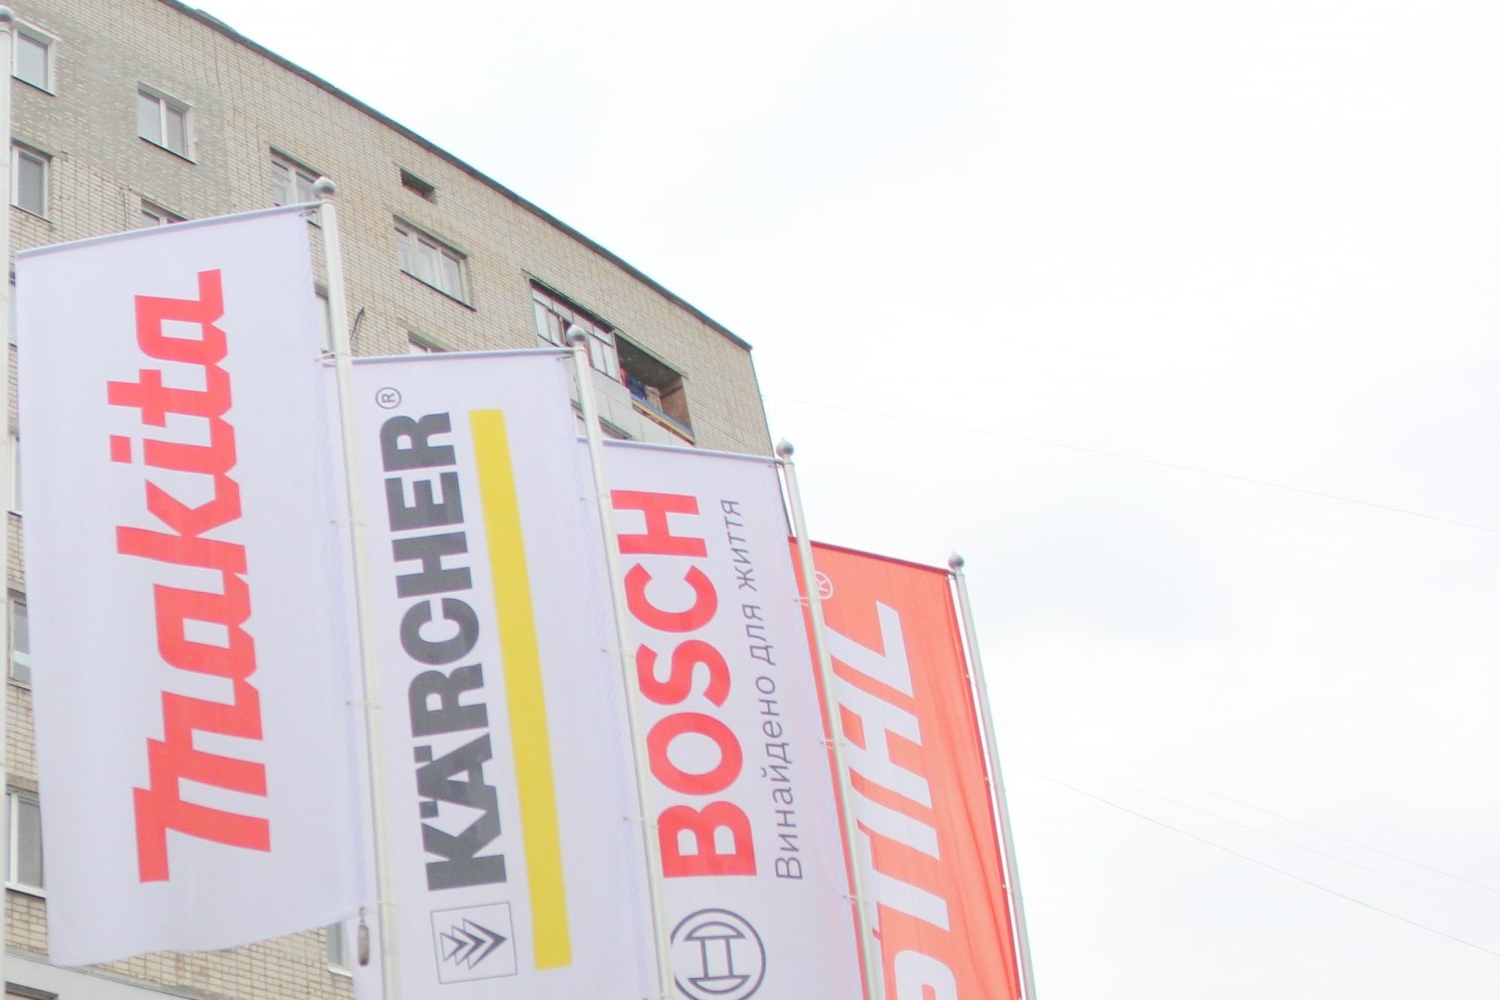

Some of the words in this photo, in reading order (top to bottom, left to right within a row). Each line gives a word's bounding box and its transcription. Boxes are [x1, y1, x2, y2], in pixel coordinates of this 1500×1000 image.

[720, 498, 752, 592] життя
[743, 603, 773, 667] для
[379, 410, 508, 892] KÄRCHER
[611, 489, 758, 879] BOSCH
[754, 675, 804, 881] Винайдено
